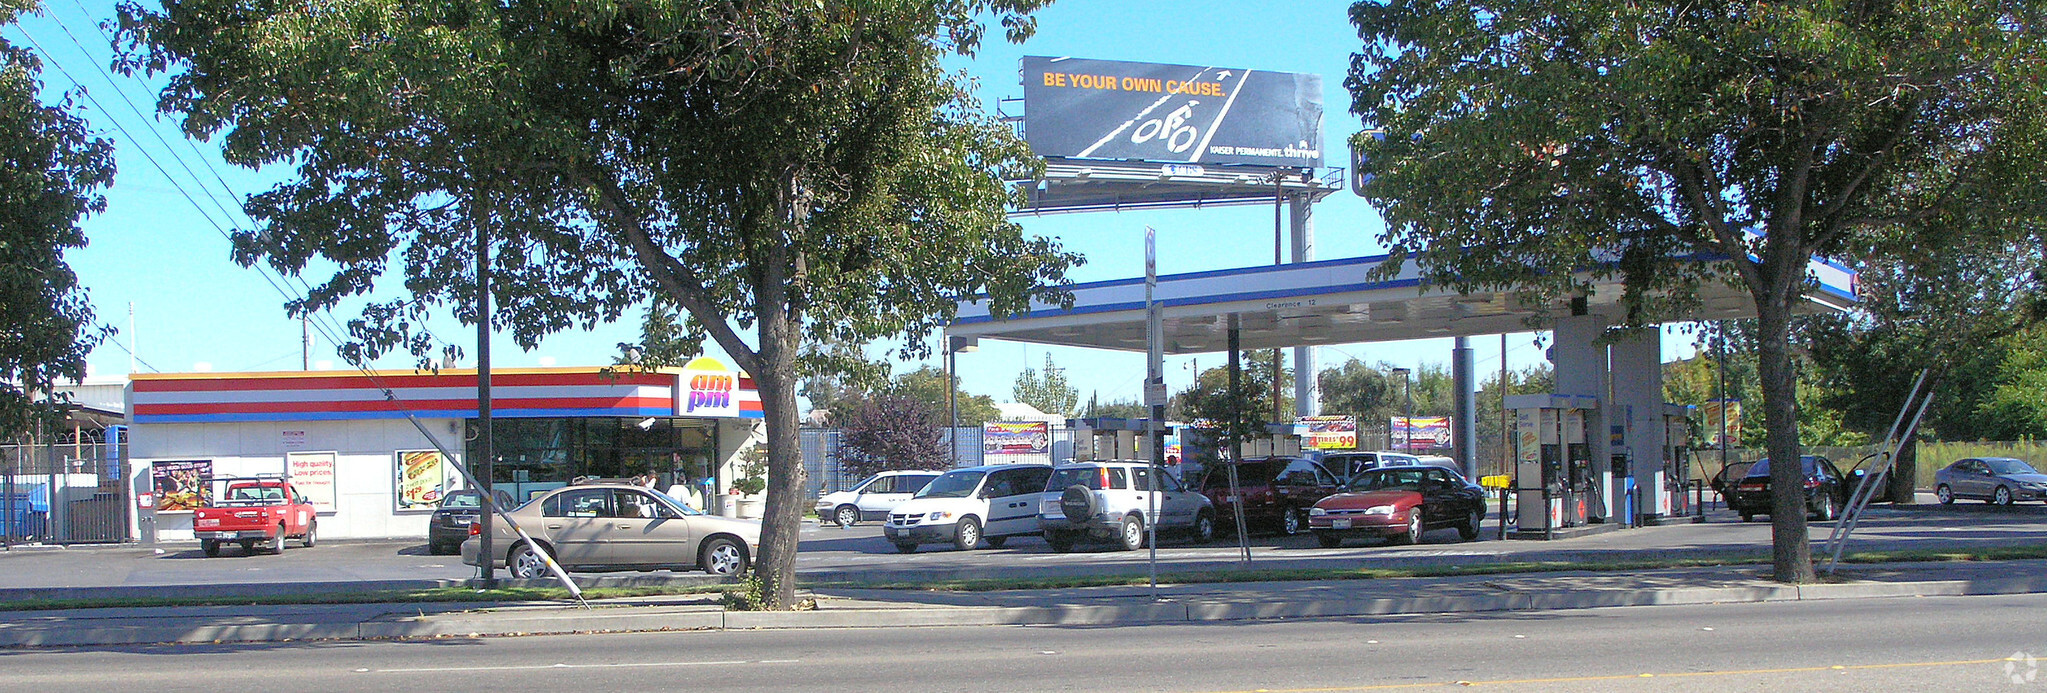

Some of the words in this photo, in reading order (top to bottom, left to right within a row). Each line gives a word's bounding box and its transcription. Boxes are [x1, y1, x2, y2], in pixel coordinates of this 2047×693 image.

[1043, 72, 1066, 87] BE
[1068, 73, 1117, 90] YOUR
[1122, 77, 1162, 93] OWN
[1166, 79, 1227, 97] CAUSE.
[1209, 145, 1235, 155] KAISER
[1283, 141, 1319, 160] thrive
[1266, 301, 1301, 309] Clearance
[1308, 298, 1316, 306] 12
[690, 374, 733, 392] am
[686, 391, 730, 413] pm
[1308, 436, 1318, 447] 4
[293, 460, 309, 469] High
